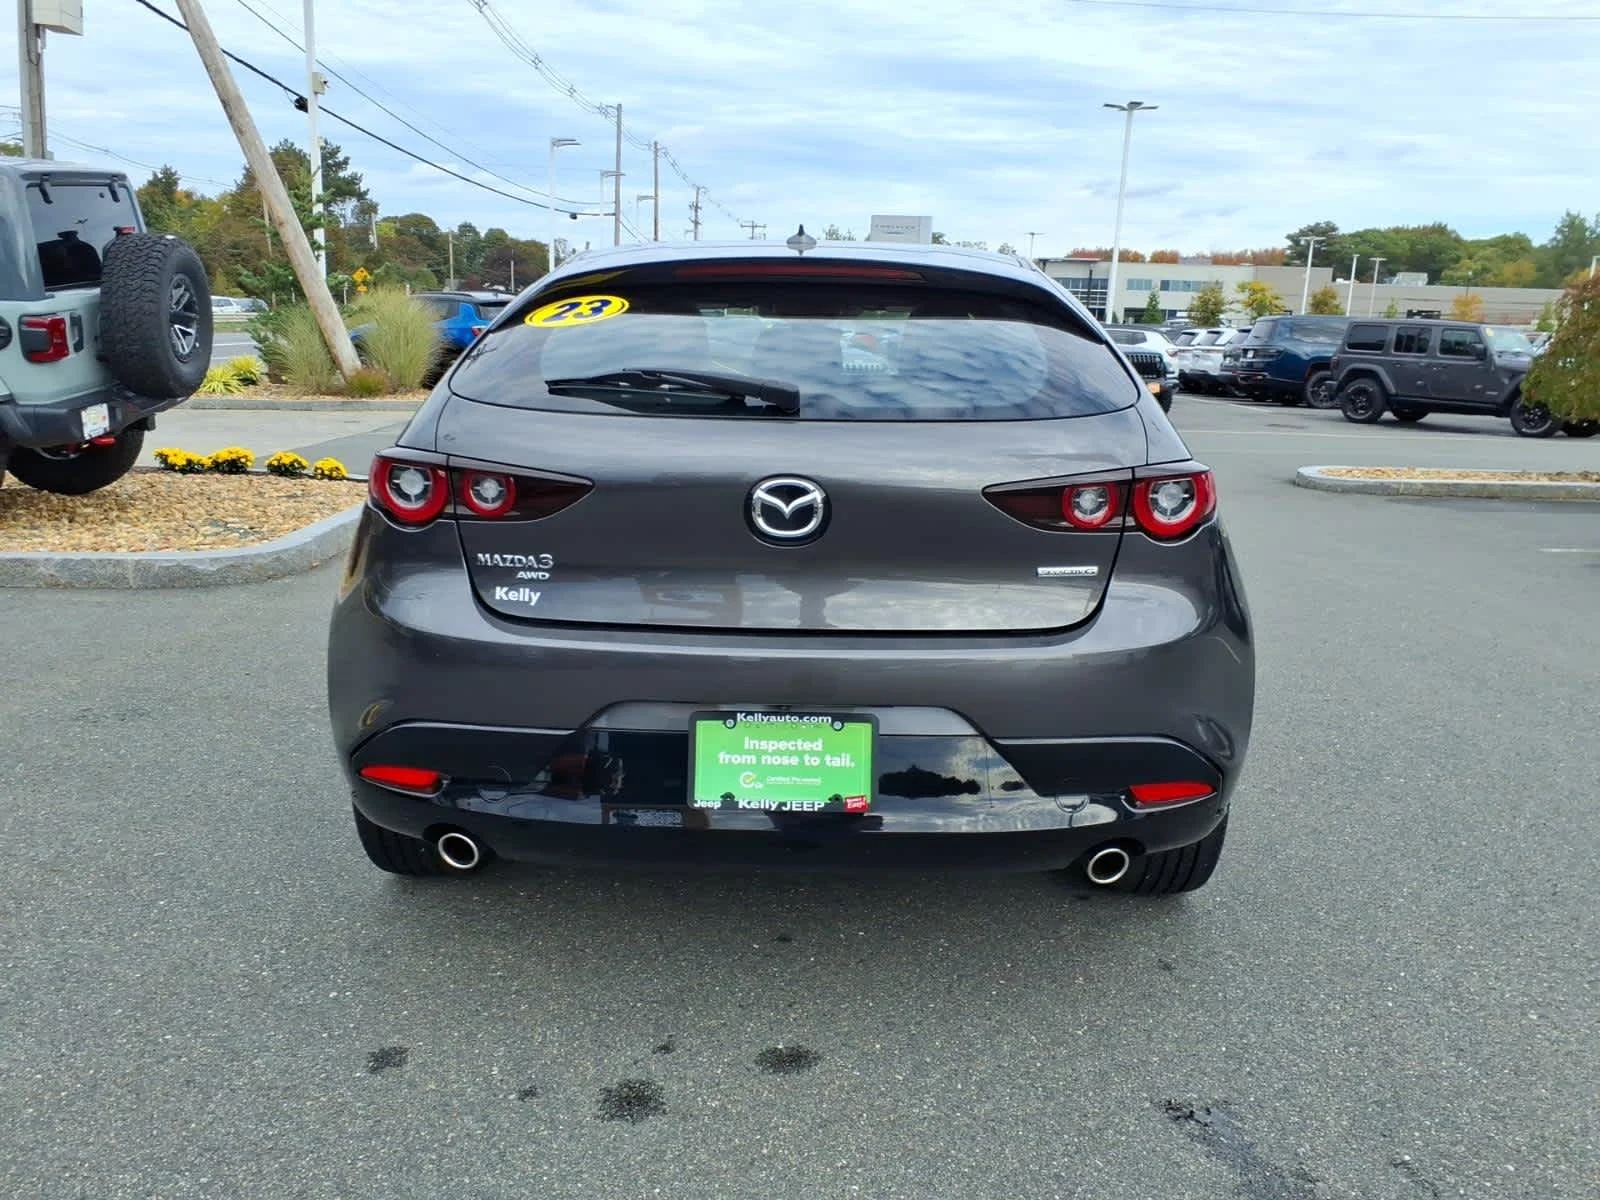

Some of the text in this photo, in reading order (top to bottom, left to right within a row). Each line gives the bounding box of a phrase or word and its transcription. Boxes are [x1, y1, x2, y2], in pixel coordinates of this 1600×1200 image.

[542, 299, 612, 322] 23
[477, 553, 554, 569] MAZDA3
[516, 571, 550, 580] AWD
[495, 586, 541, 606] Kelly
[736, 712, 832, 724] Kellyauto.com
[744, 736, 823, 752] Inspected
[718, 752, 855, 768] from nose to tail.
[694, 800, 721, 809] Jeep
[738, 799, 825, 811] Kelly JEEP
